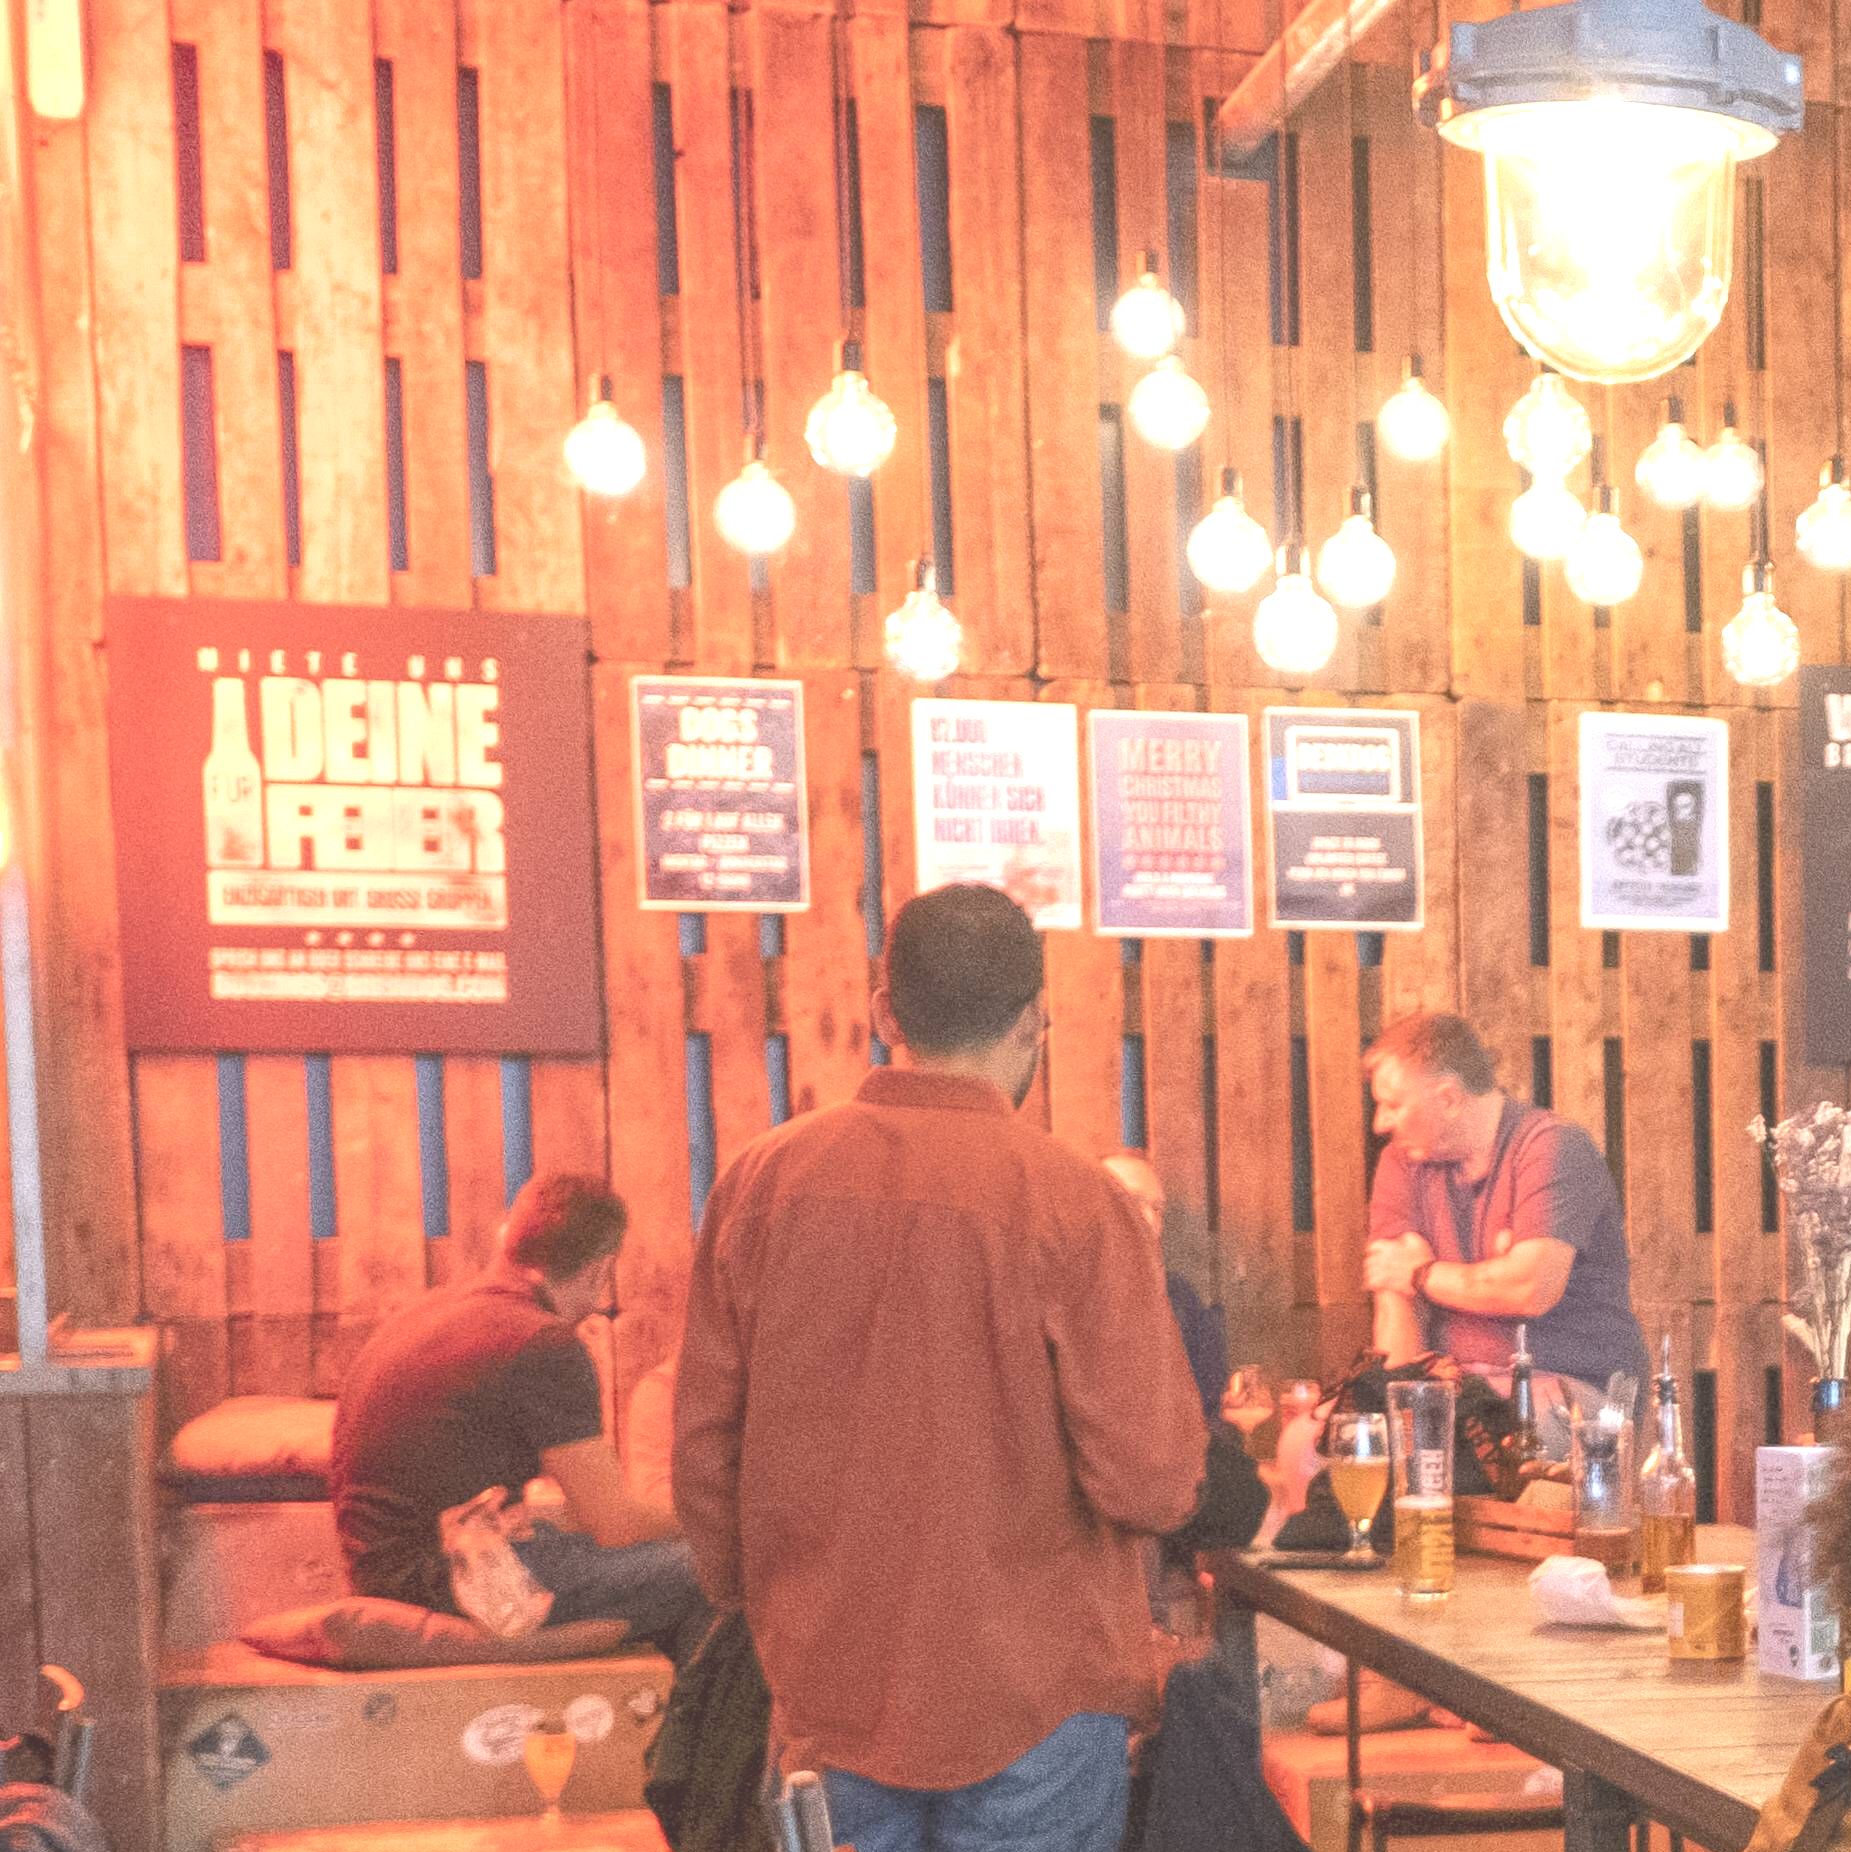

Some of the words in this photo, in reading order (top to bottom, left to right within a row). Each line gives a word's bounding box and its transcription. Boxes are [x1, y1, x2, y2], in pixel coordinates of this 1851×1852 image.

[196, 646, 359, 675] MIETE
[407, 653, 500, 680] UNS
[259, 676, 502, 787] DEINE
[681, 707, 758, 742] DOGS
[667, 743, 774, 779] DINNER
[932, 751, 1023, 778] MENSCHEN
[1118, 737, 1222, 774] MERRY
[933, 779, 1002, 810] KÖNNEN
[1006, 784, 1046, 812] SICH
[1119, 775, 1223, 799] CHRISTMAS
[1120, 800, 1159, 824] YOU
[1163, 801, 1222, 824] FILTHY
[266, 786, 505, 873] FEIER
[934, 817, 983, 844] NICHT
[1120, 826, 1225, 852] ANIMALS
